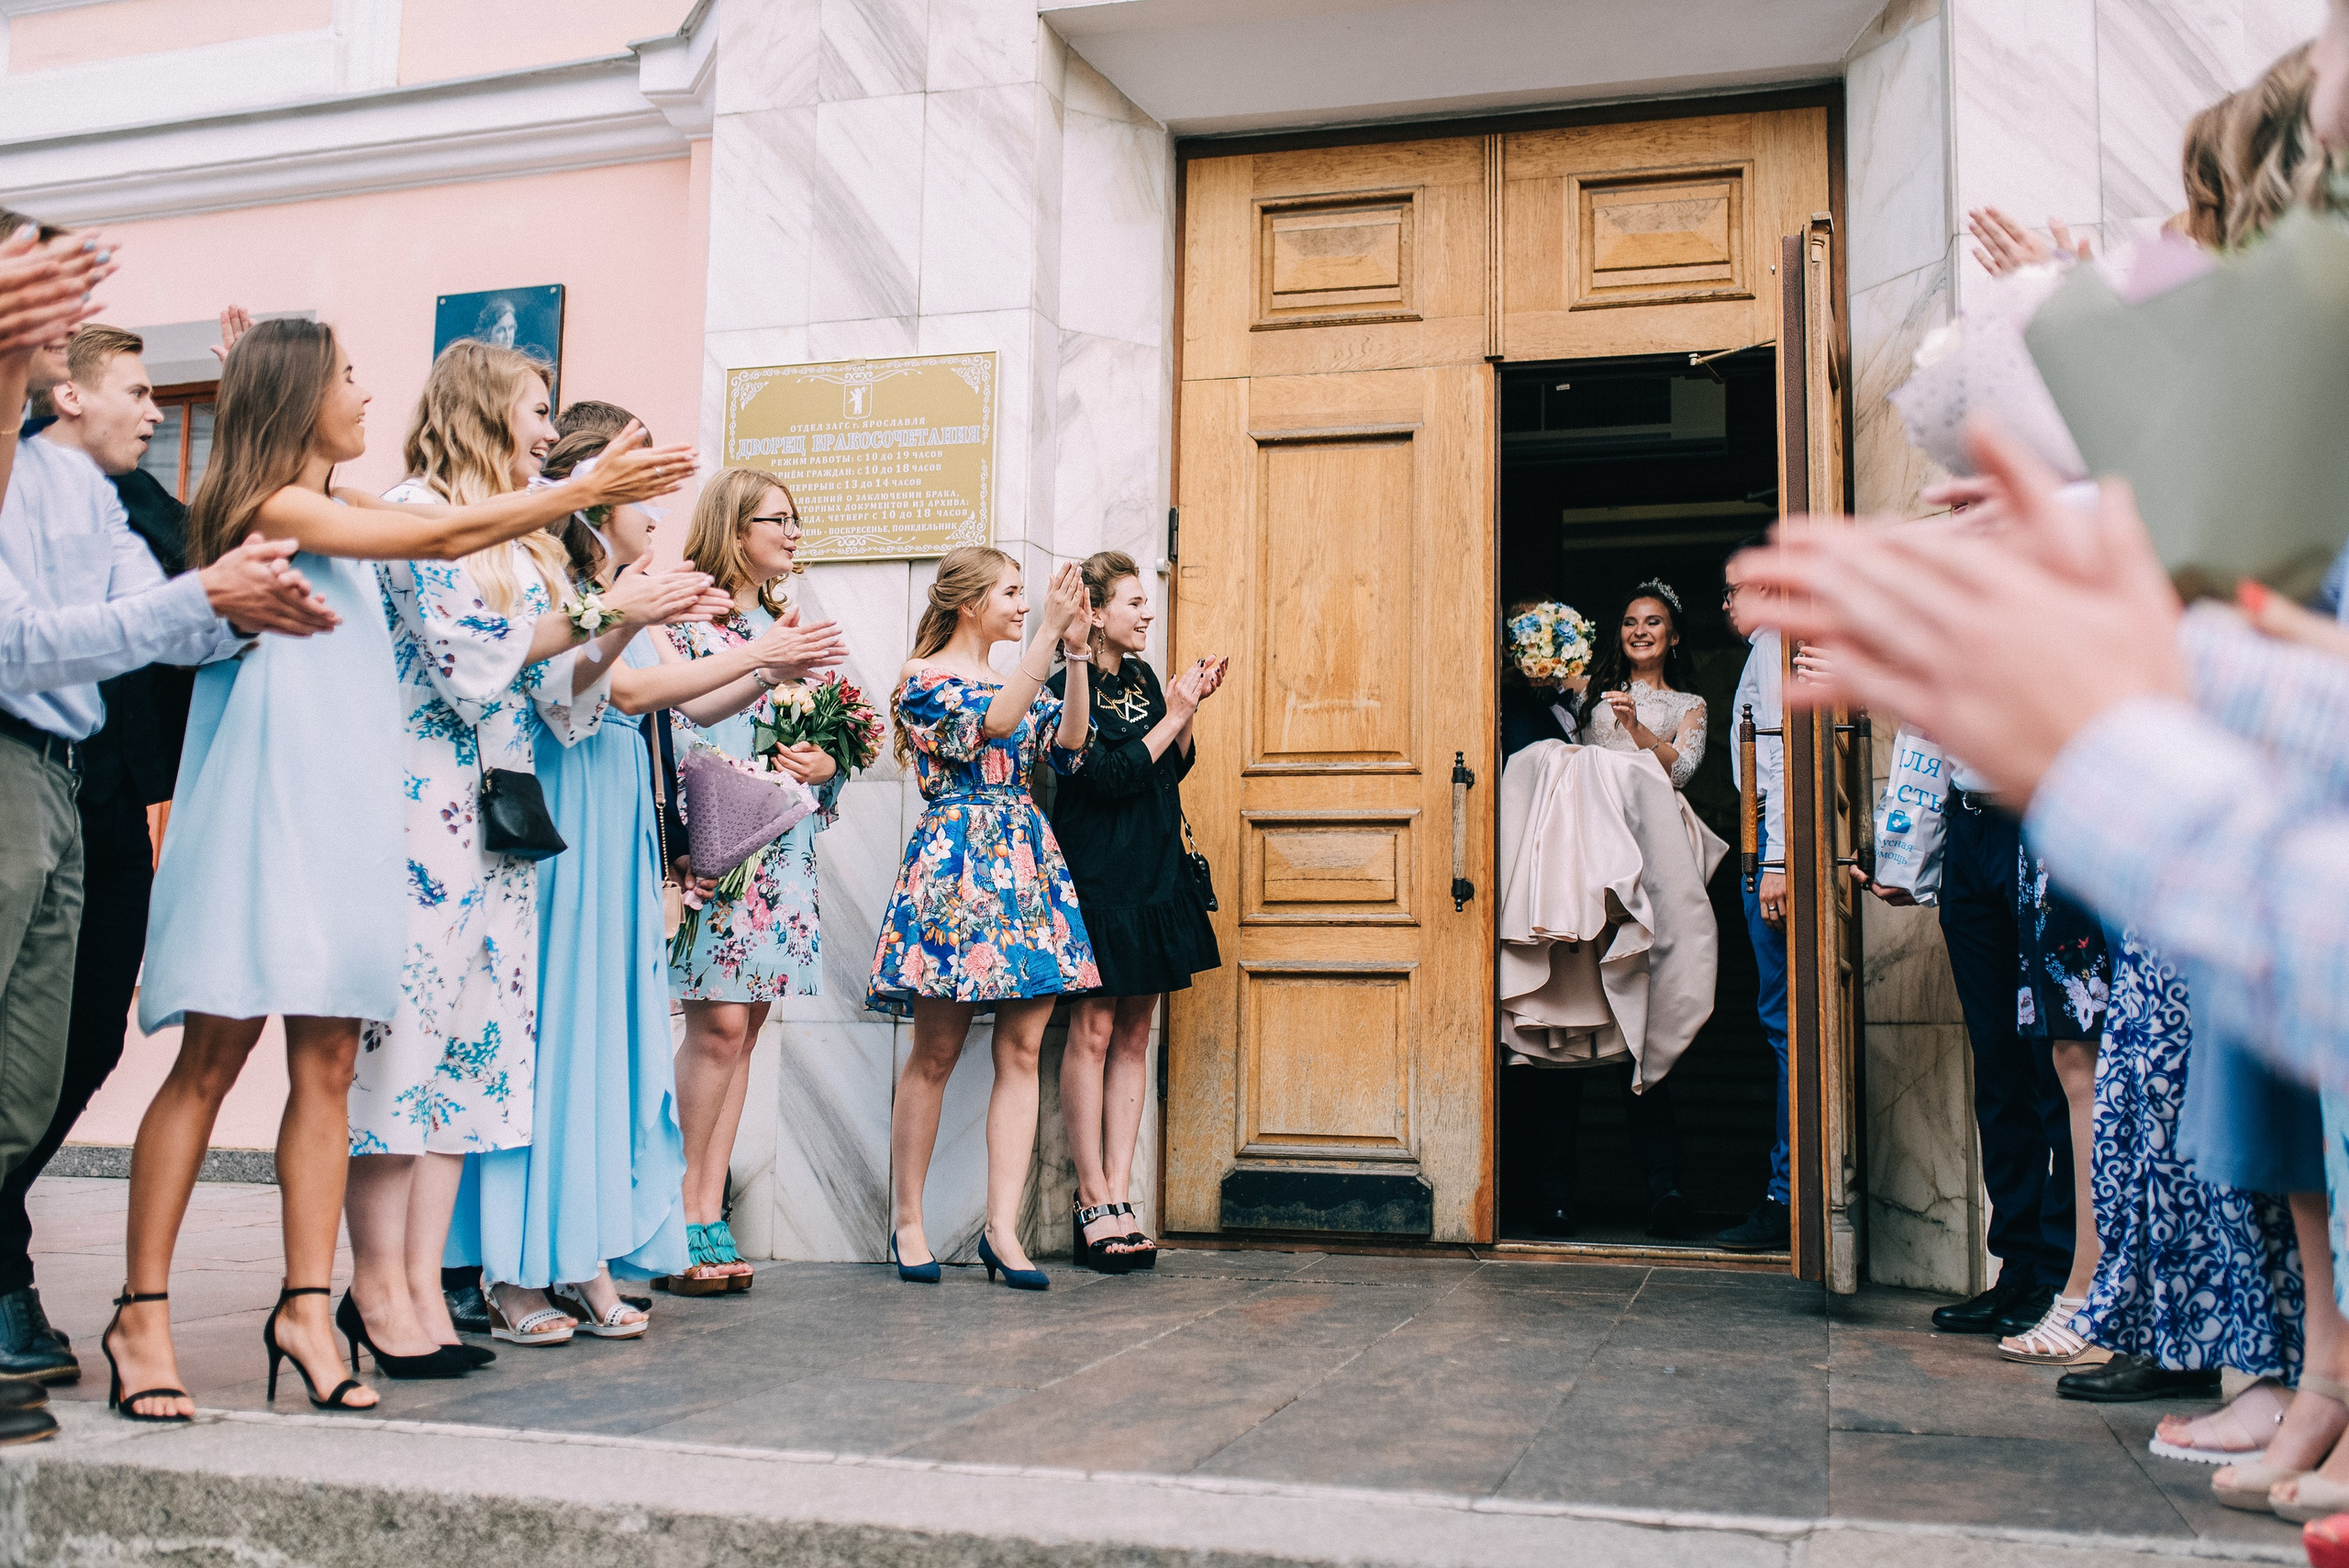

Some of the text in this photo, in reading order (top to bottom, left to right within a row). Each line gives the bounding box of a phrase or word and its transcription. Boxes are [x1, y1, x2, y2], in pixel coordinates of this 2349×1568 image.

[790, 423, 823, 433] ОТДЕЛ
[826, 422, 850, 431] ЗАГС
[863, 417, 925, 428] ЯРОСЛАВЛЯ
[736, 425, 980, 460] ДВОРЕЦ БРАКОСОЧЕТАНИЯ
[771, 458, 807, 467] РЕЖИМ
[810, 455, 854, 465] РАБОТЫ:
[865, 452, 878, 462] 10
[896, 451, 909, 460] 19
[865, 465, 878, 475] 10
[896, 464, 910, 473] 18
[789, 482, 834, 492] ПЕРЕРЫВ
[844, 479, 858, 489] 13
[875, 478, 889, 487] 14
[856, 491, 922, 501] ЗАКЛЮЧЕНИИ
[926, 490, 960, 498] БРАКА,
[844, 501, 909, 512] ДОКУМЕНТОВ
[828, 513, 869, 522] ЧЕТВЕРГ
[882, 510, 896, 520] 10
[917, 508, 931, 518] 18
[937, 509, 968, 517] ЧАСОВ
[893, 522, 958, 532] ПОНЕДЕЛЬНИК
